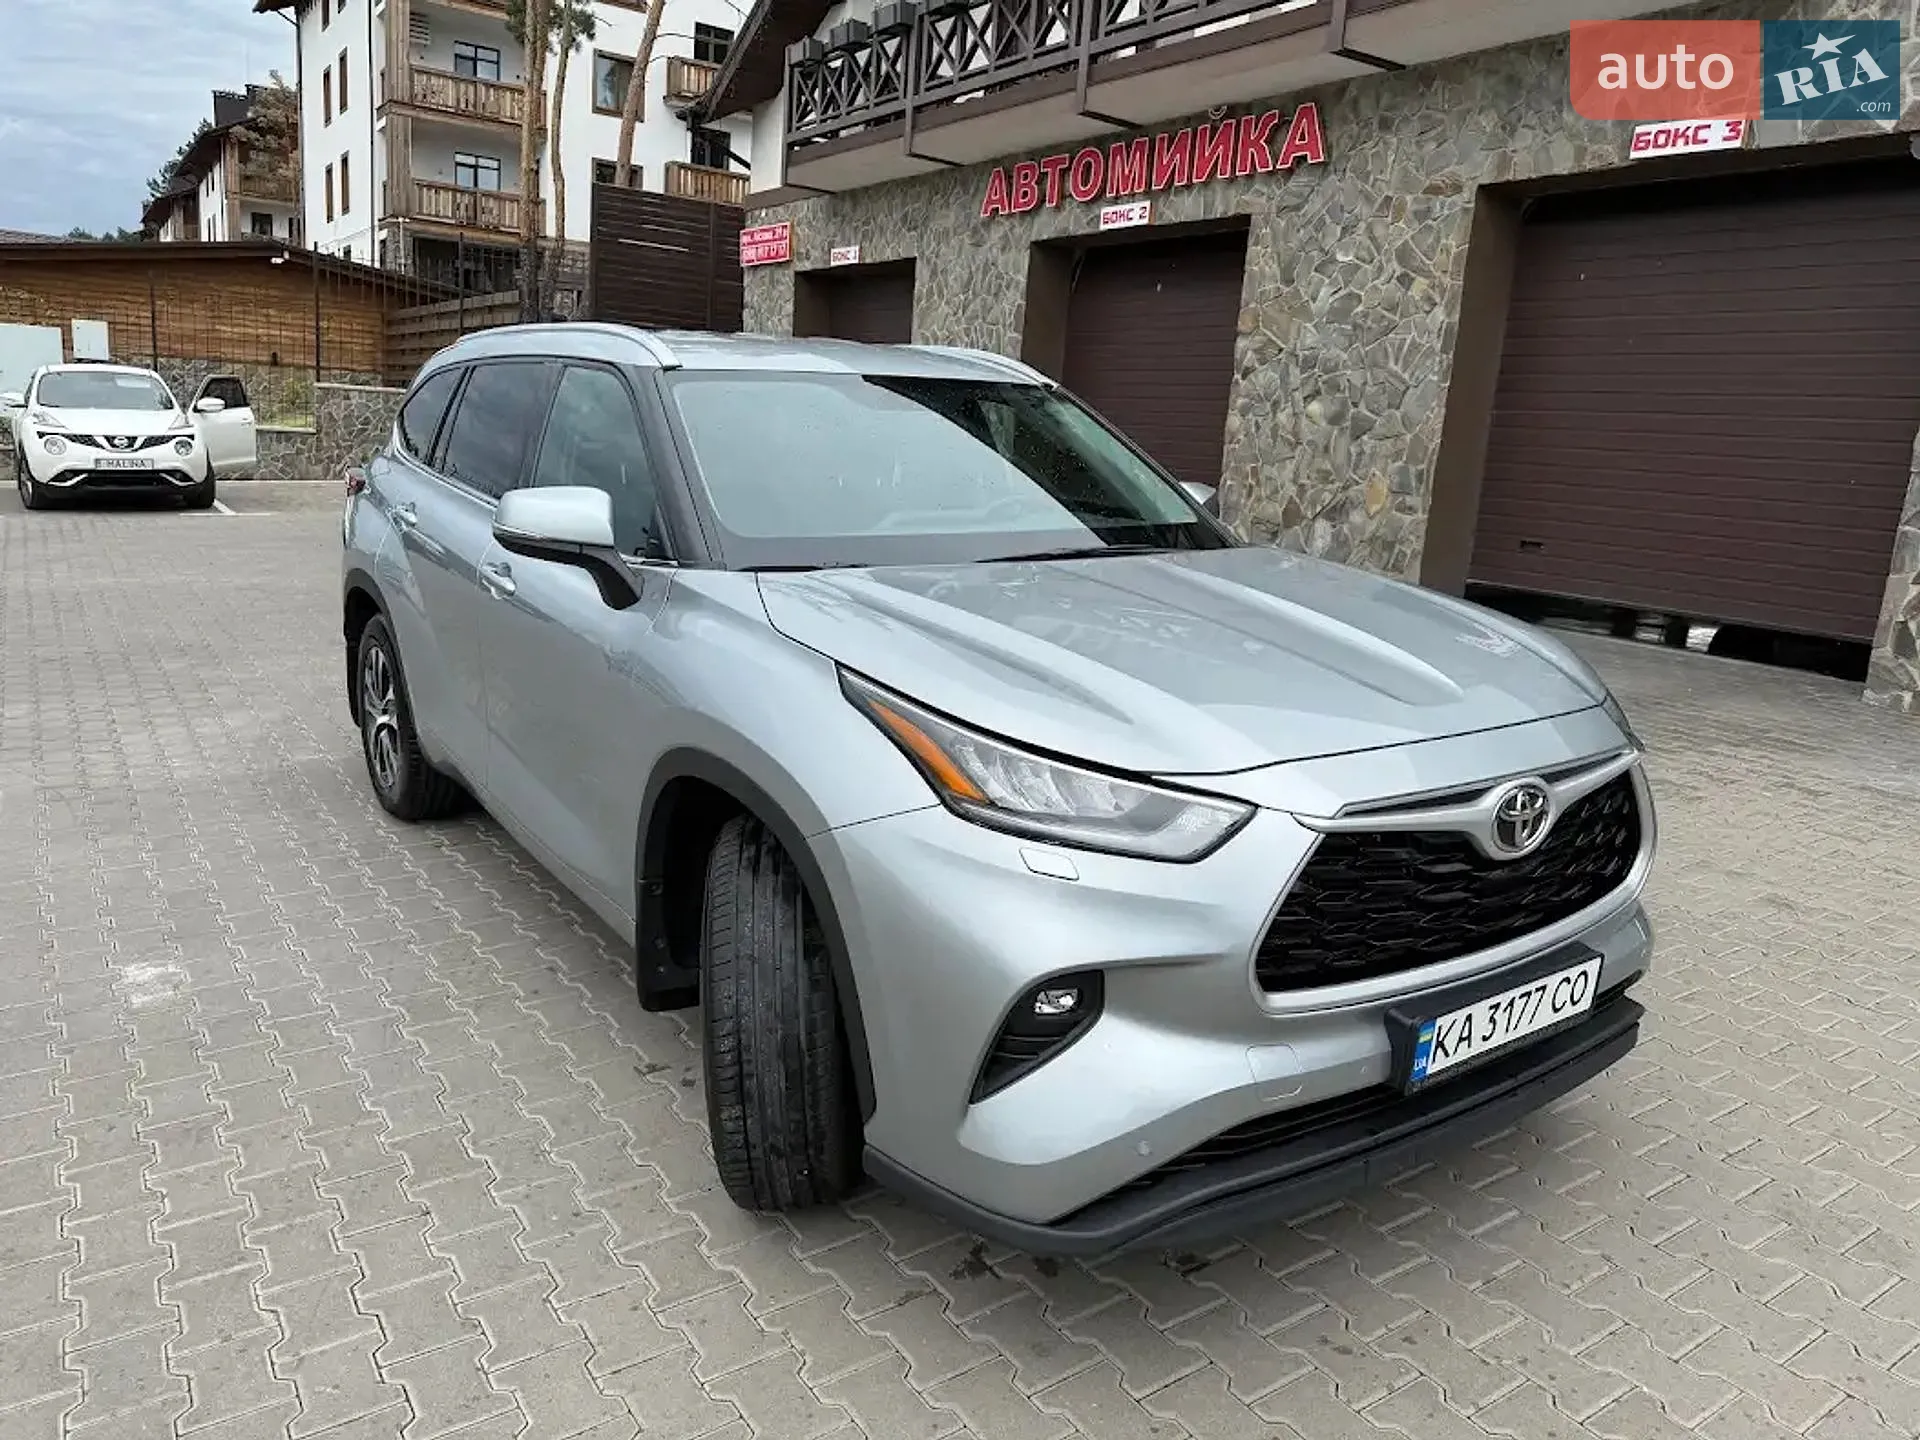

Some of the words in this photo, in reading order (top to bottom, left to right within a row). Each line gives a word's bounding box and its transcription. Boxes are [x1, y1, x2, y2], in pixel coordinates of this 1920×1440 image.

[980, 102, 1326, 217] АВТОМИЙКА
[1632, 124, 1711, 152] БОКС
[1722, 120, 1743, 142] 3
[1102, 208, 1134, 225] БОКС
[1138, 206, 1148, 220] 2
[1431, 1013, 1473, 1064] KA
[1482, 984, 1548, 1042] 3177
[1551, 969, 1589, 1014] CO
